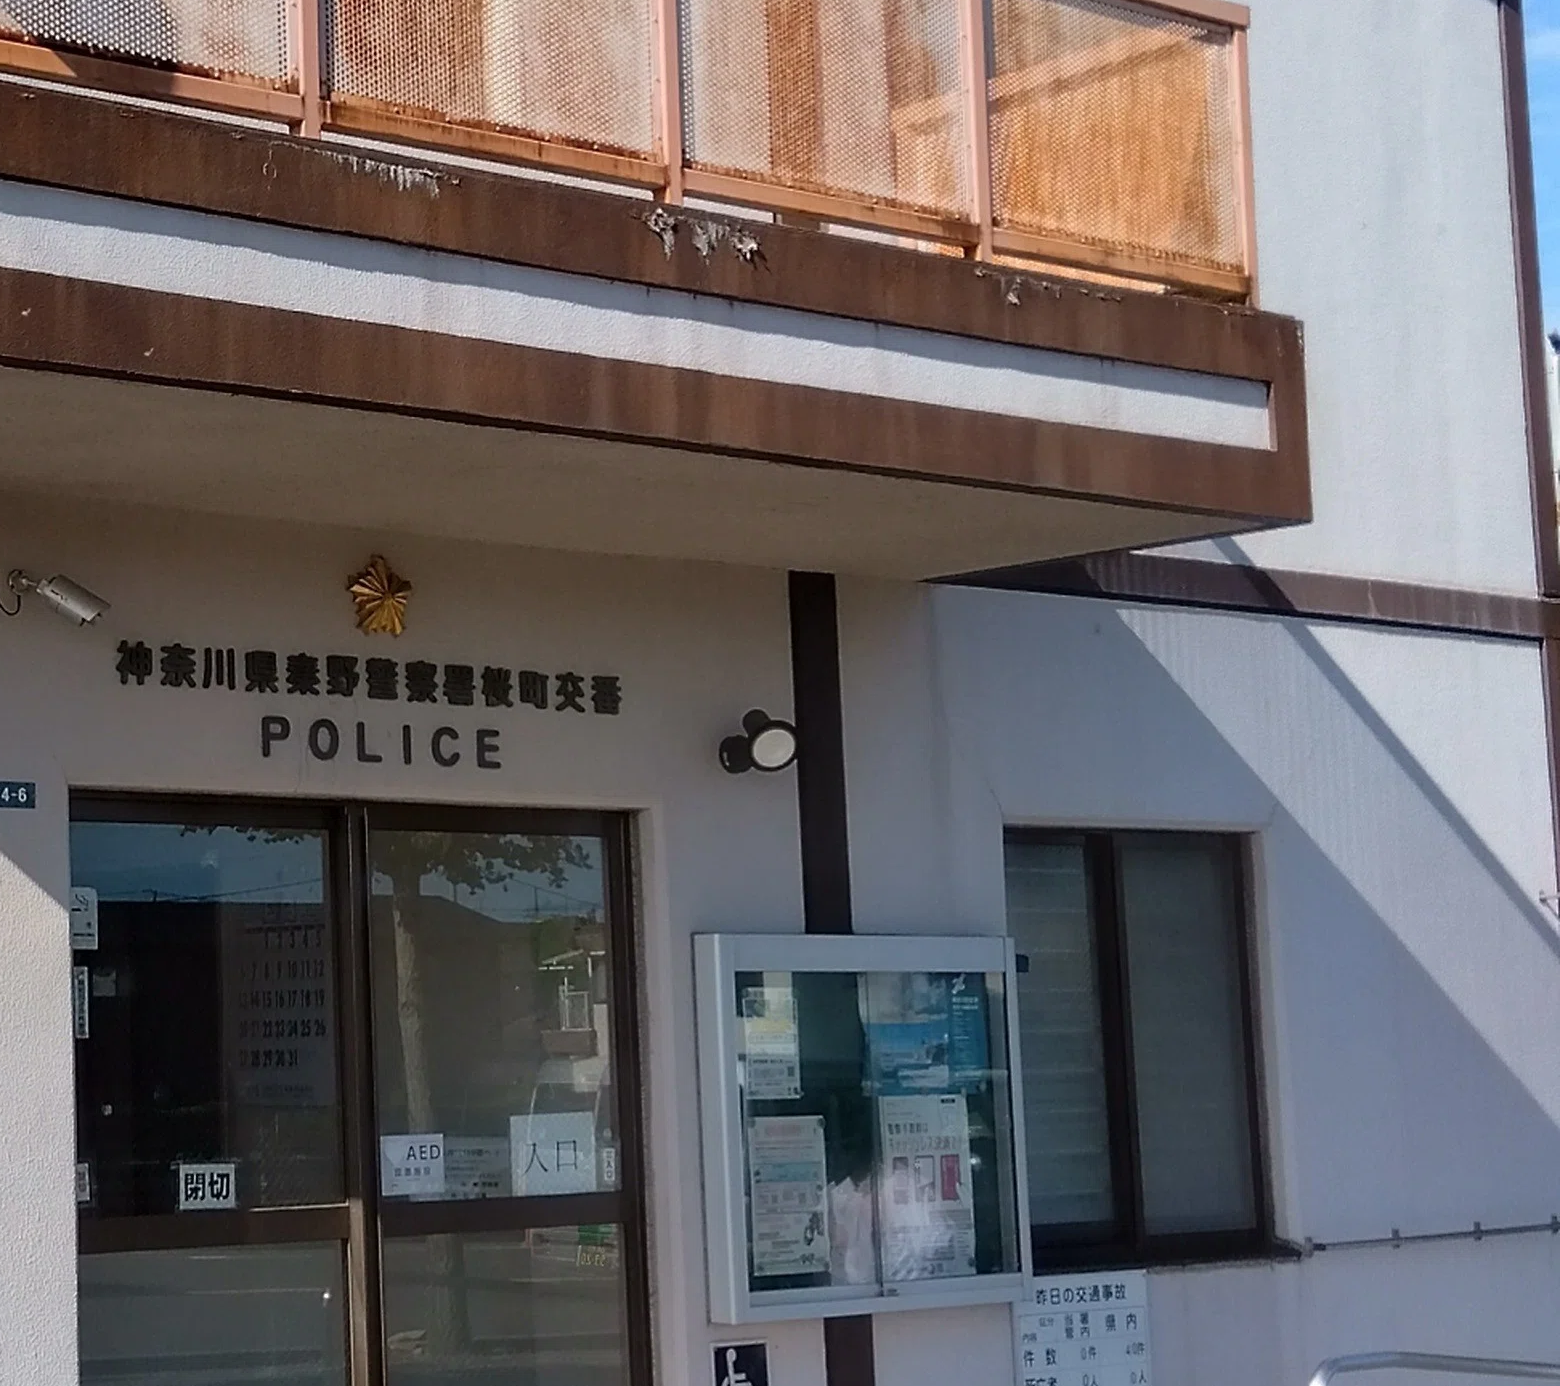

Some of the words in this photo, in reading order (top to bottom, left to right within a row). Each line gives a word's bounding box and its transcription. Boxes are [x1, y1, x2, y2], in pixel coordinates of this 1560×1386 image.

[116, 640, 622, 715] 神奈川県秦野警察署桜町交番
[260, 716, 502, 769] POLICE
[1, 787, 28, 803] 4-6
[406, 1144, 442, 1161] AED
[524, 1140, 578, 1177] 入口
[185, 1172, 230, 1201] 閉切
[1036, 1283, 1126, 1305] 昨日の交通事故
[1130, 1369, 1146, 1384] 0人
